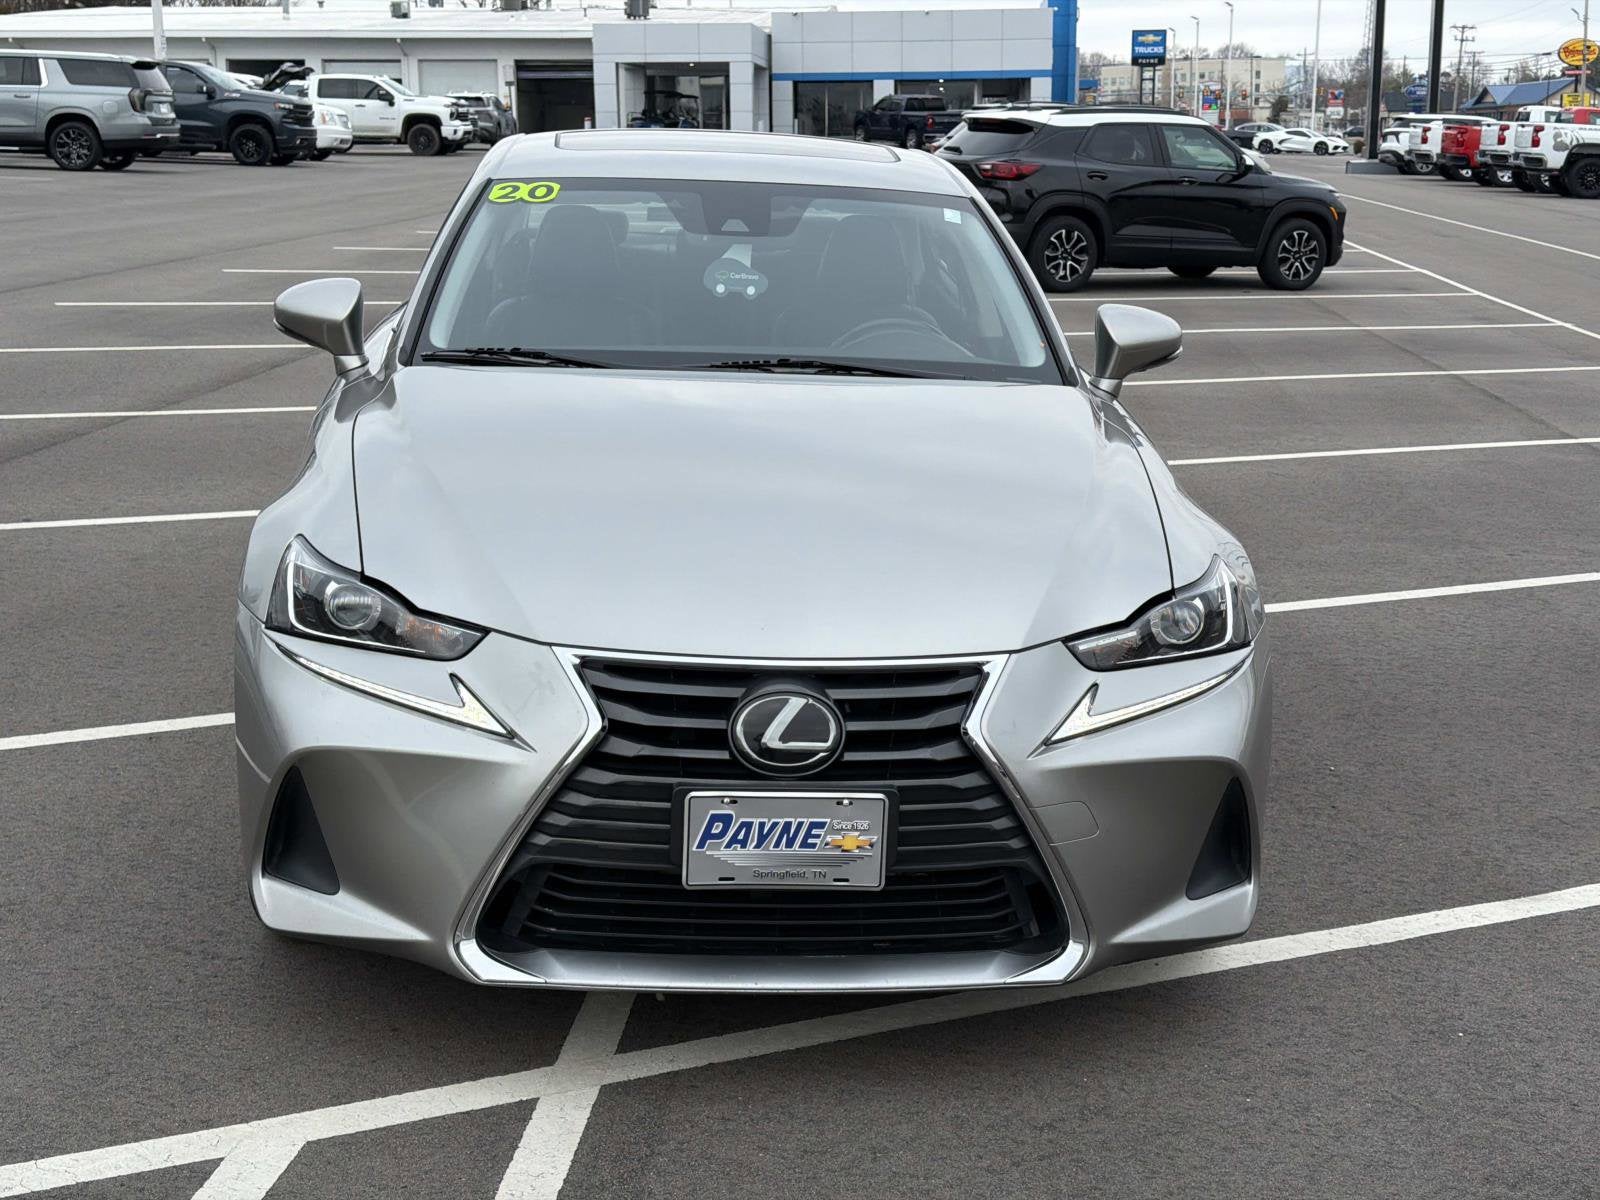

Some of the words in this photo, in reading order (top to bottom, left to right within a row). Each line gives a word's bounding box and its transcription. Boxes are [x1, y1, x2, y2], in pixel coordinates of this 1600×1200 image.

[492, 184, 556, 200] 20
[693, 810, 830, 851] PAYNE
[832, 821, 852, 830] Since
[853, 821, 870, 830] 1926
[753, 869, 809, 880] Springfield,
[813, 870, 827, 879] TN
